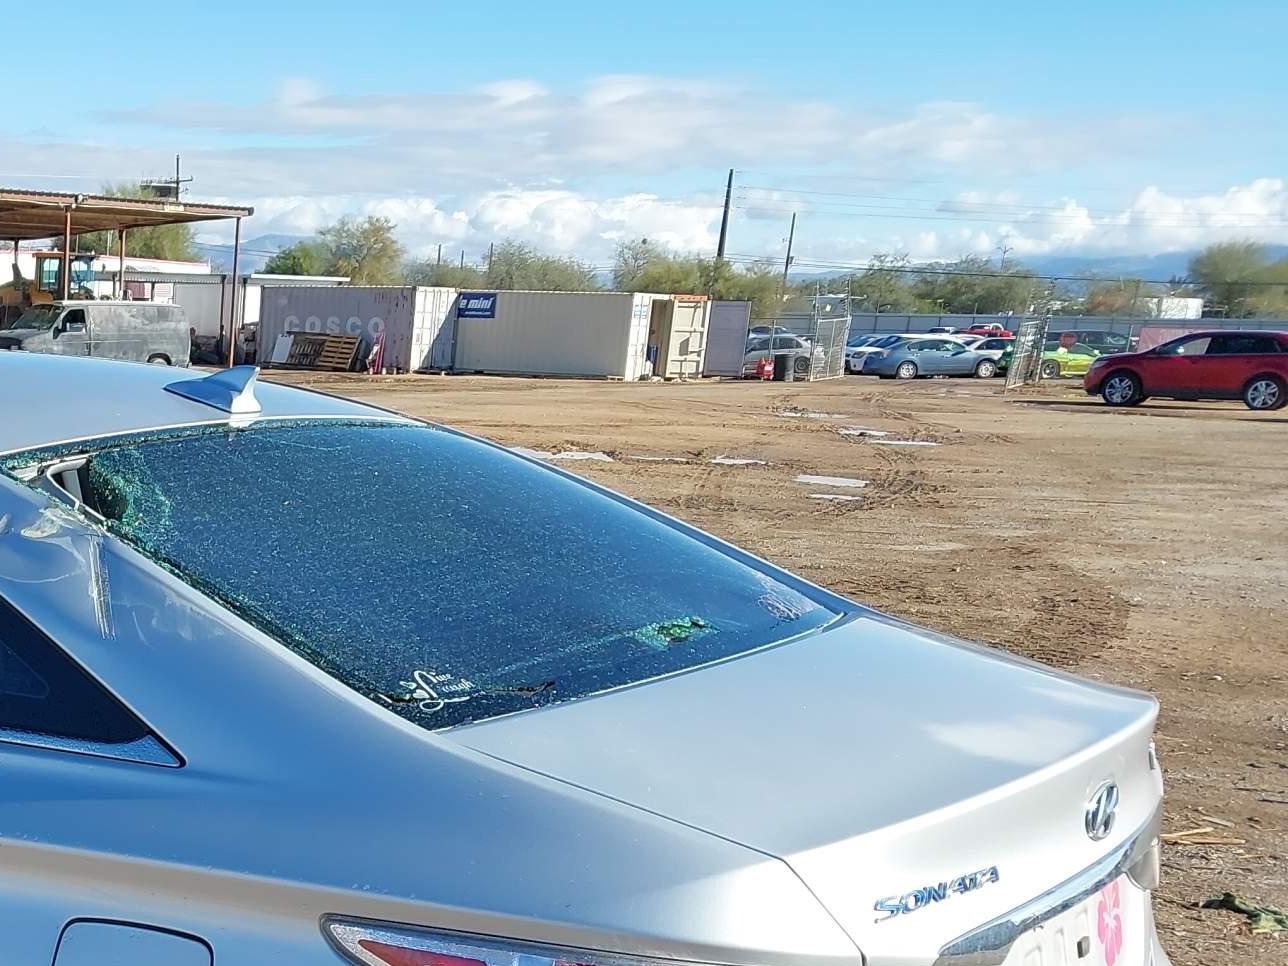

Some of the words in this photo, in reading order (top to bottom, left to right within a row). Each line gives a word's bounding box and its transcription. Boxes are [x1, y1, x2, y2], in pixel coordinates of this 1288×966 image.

[467, 297, 495, 309] mini
[284, 315, 385, 337] COSCO
[873, 865, 1000, 923] SONATA
